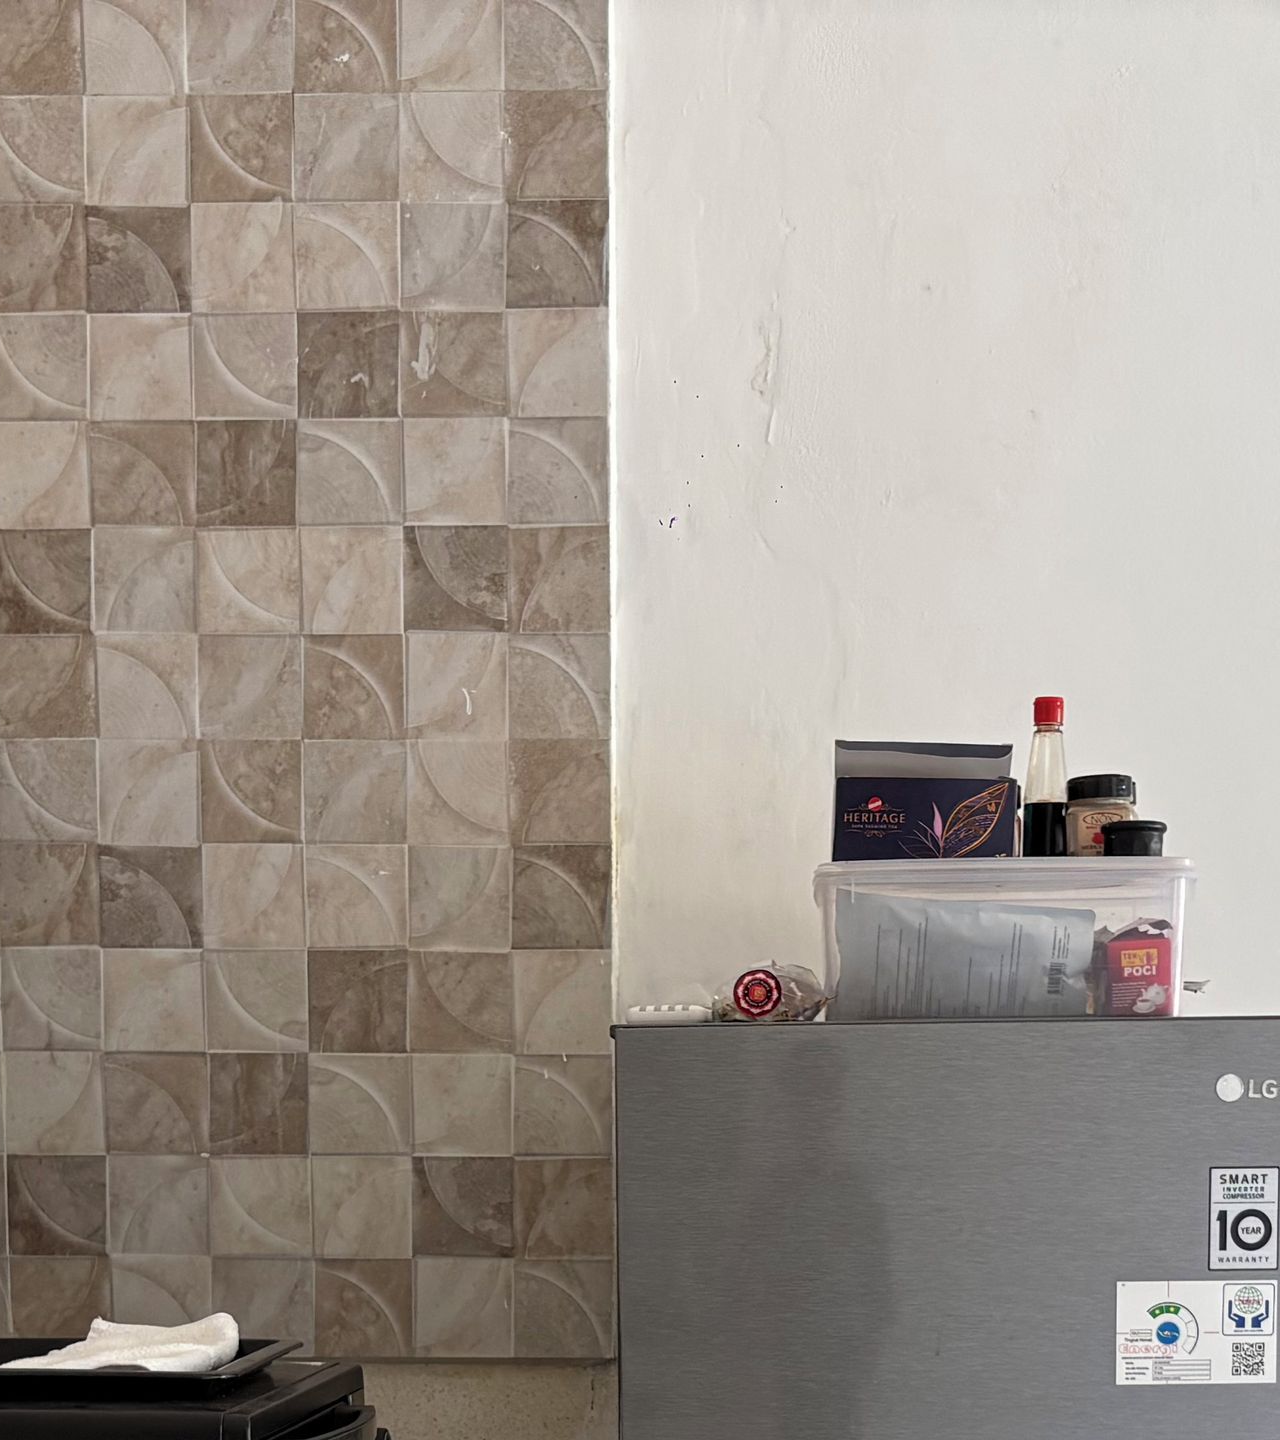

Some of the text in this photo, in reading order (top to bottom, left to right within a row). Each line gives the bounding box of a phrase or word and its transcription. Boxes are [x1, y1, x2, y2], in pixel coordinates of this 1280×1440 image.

[843, 812, 907, 824] HERITAGE
[1124, 965, 1157, 977] POCI
[1248, 1079, 1280, 1099] LG
[1219, 1173, 1269, 1185] SMART
[1216, 1208, 1273, 1252] 10
[1240, 1227, 1262, 1235] YEAR
[1217, 1256, 1270, 1264] WARRANTY
[1119, 1341, 1178, 1356] Energi
